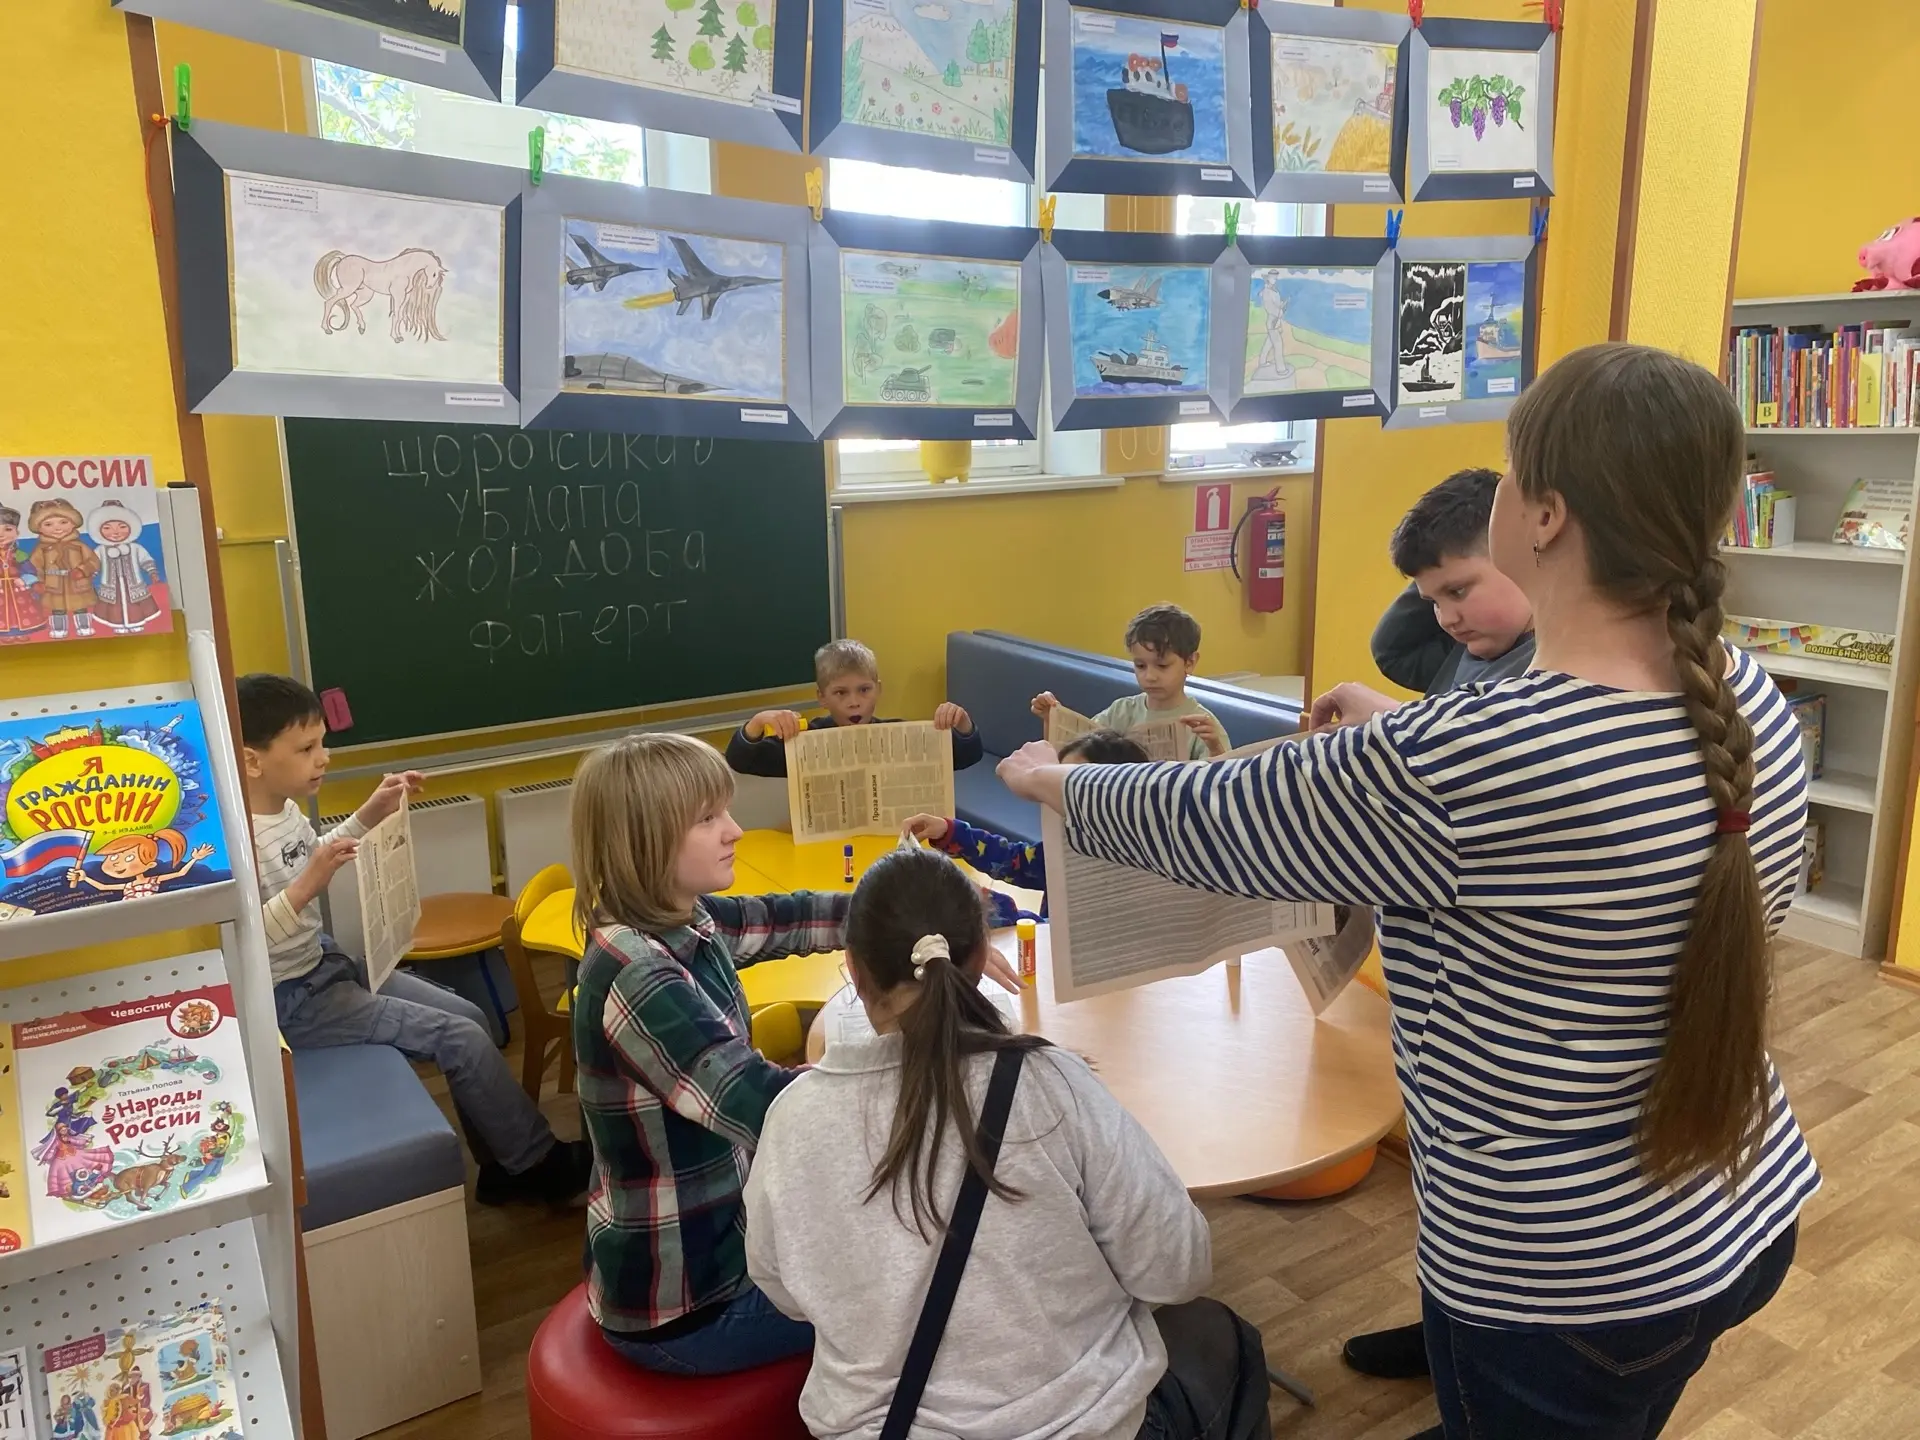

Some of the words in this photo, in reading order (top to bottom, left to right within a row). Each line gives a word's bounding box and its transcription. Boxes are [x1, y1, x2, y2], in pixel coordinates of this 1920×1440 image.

[9, 459, 148, 490] РОССИИ
[1805, 644, 1866, 660] ВОЛШЕБНЫЙ
[78, 757, 104, 777] Я
[15, 773, 171, 811] ГРАЖДАНИН
[27, 792, 164, 831] РОССИИ
[111, 1000, 173, 1019] Чевостик
[21, 1023, 58, 1035] Детская
[22, 1024, 87, 1041] энциклопедия
[118, 1085, 150, 1097] Татьяна
[152, 1079, 183, 1091] Попова
[116, 1089, 203, 1118] Народы
[105, 1110, 201, 1145] России
